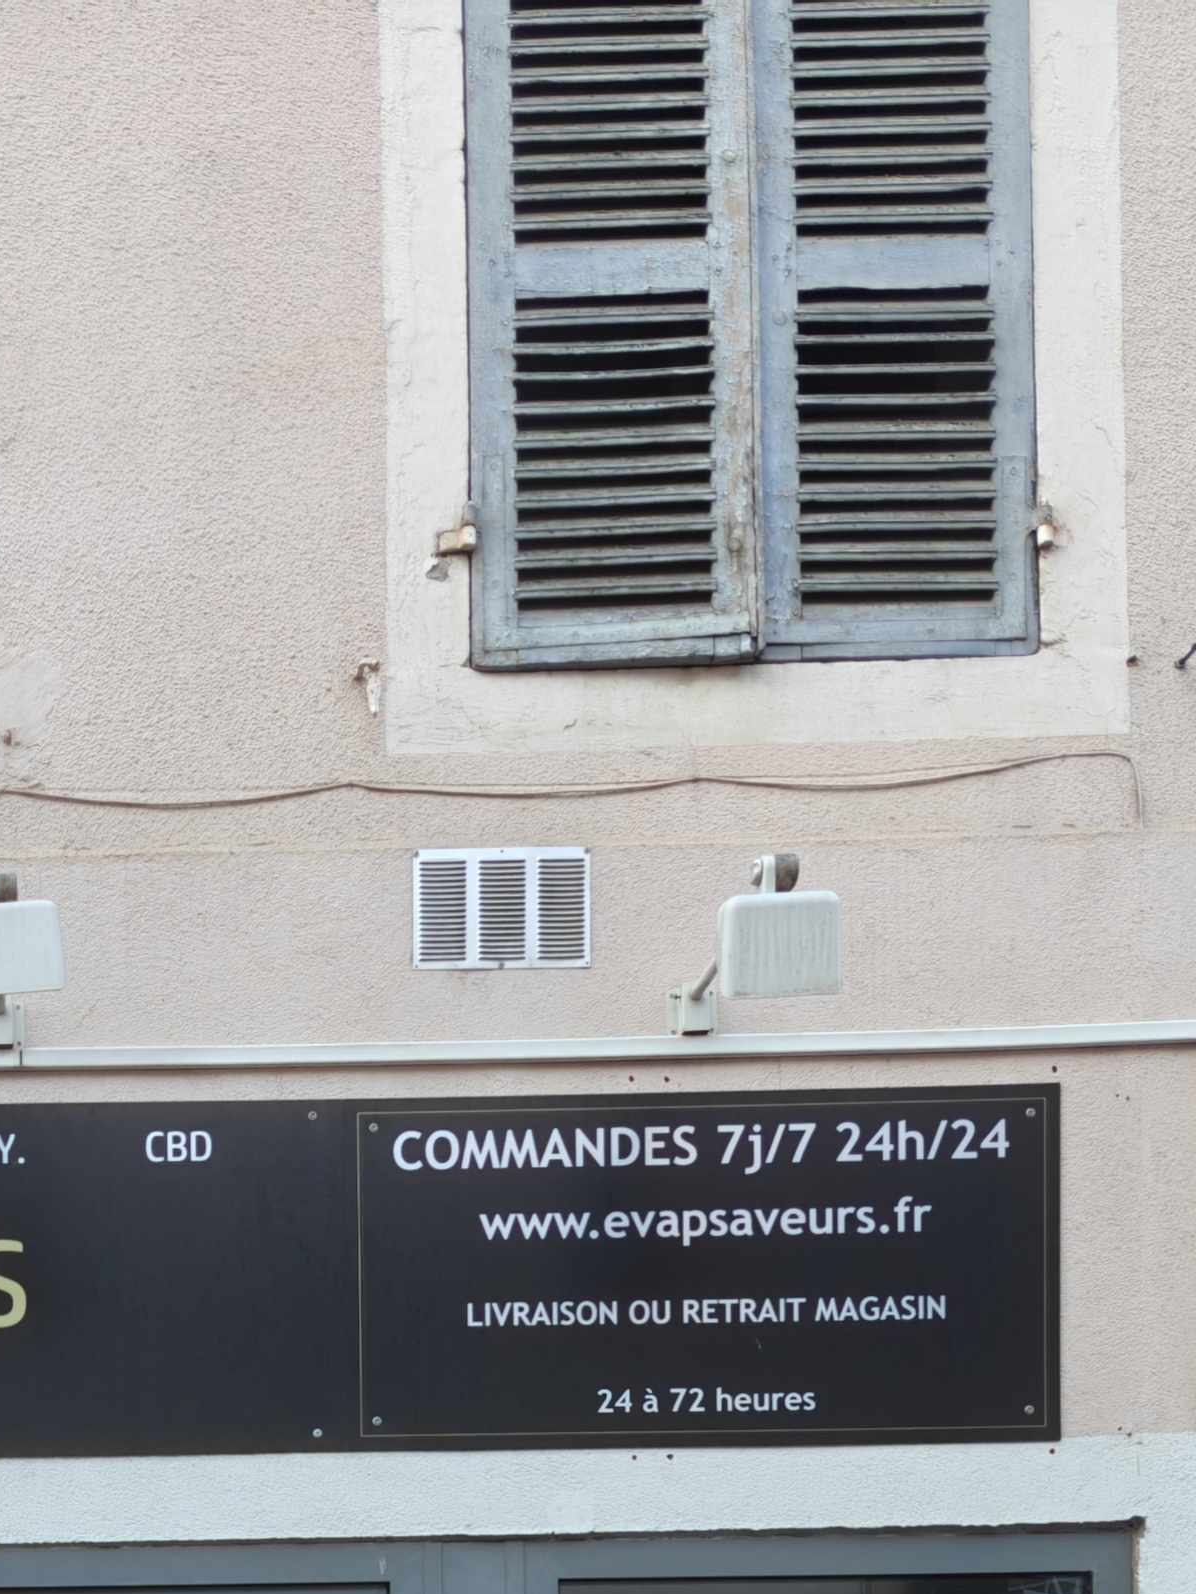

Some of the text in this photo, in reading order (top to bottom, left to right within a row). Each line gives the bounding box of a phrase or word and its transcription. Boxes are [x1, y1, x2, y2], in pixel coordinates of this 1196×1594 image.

[145, 1130, 212, 1163] CBD
[392, 1118, 1010, 1175] COMMANDES 7j/7 24h/24
[478, 1195, 932, 1247] www.evapsaveurs.fr
[466, 1294, 946, 1327] LIVRAISON OU RETRAIT MAGASIN
[597, 1386, 816, 1414] 24 à 72 heures
